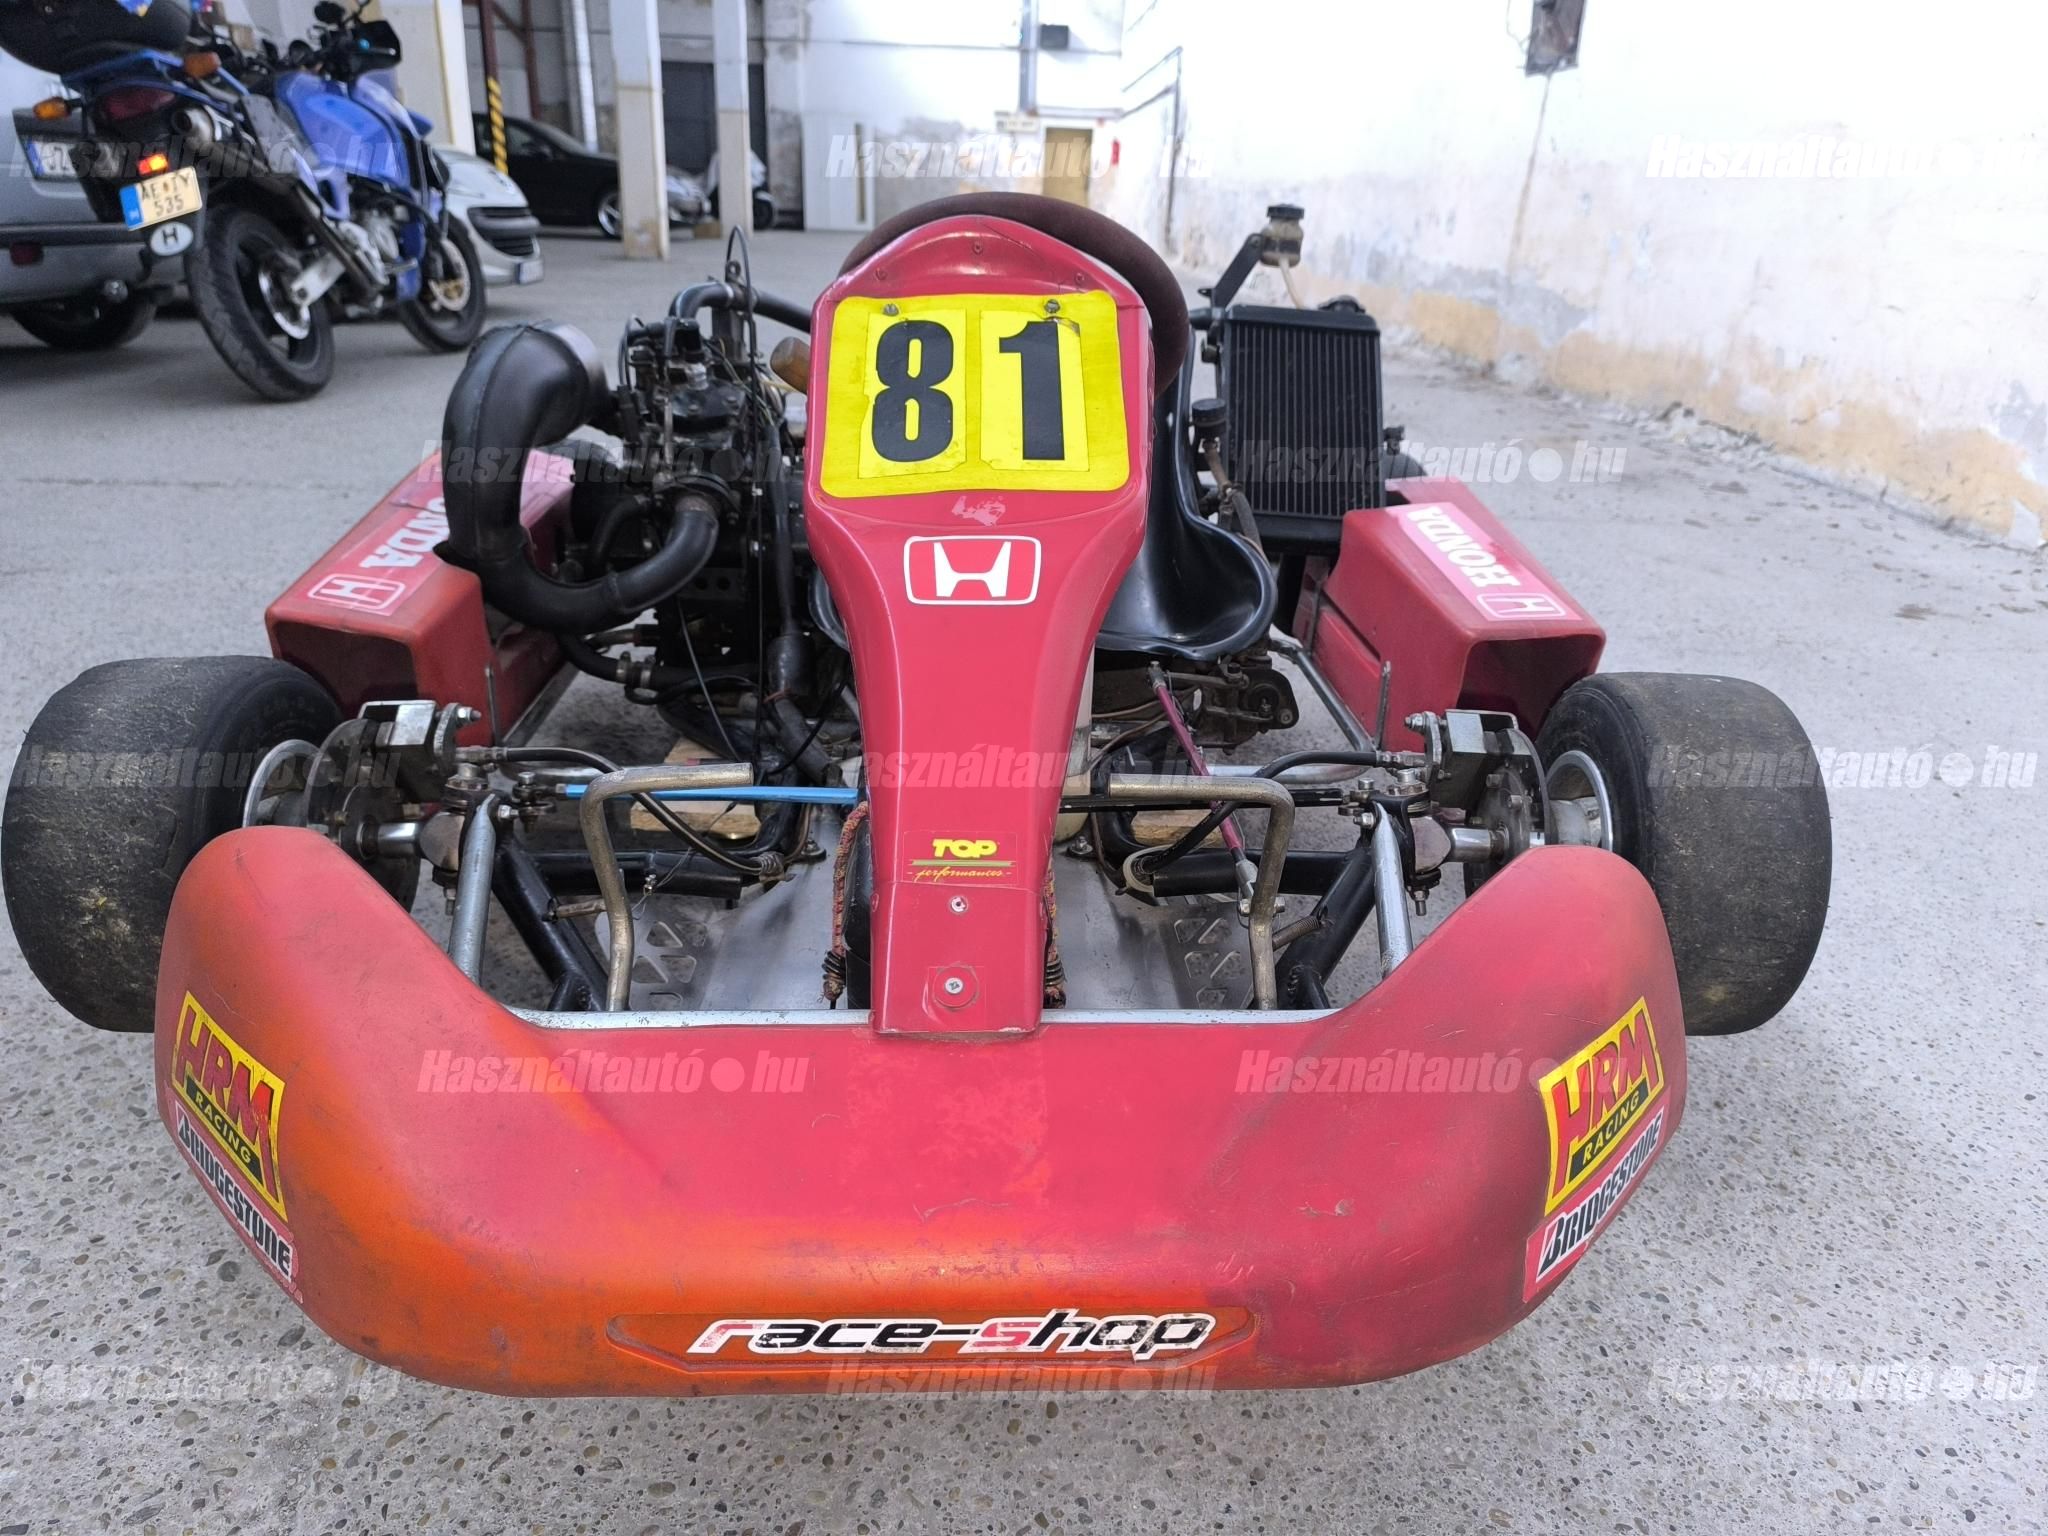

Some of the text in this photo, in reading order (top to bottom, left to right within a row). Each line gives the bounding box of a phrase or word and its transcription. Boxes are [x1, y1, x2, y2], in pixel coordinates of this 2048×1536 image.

[162, 227, 178, 246] H
[872, 319, 1065, 463] 81
[1407, 506, 1521, 588] HONDA
[932, 838, 998, 858] TOP
[176, 1003, 279, 1202] HRM
[194, 1091, 252, 1164] RACING
[1551, 1007, 1660, 1201] HRM
[1582, 1089, 1640, 1166] RACING
[690, 1309, 1214, 1359] race-shop
